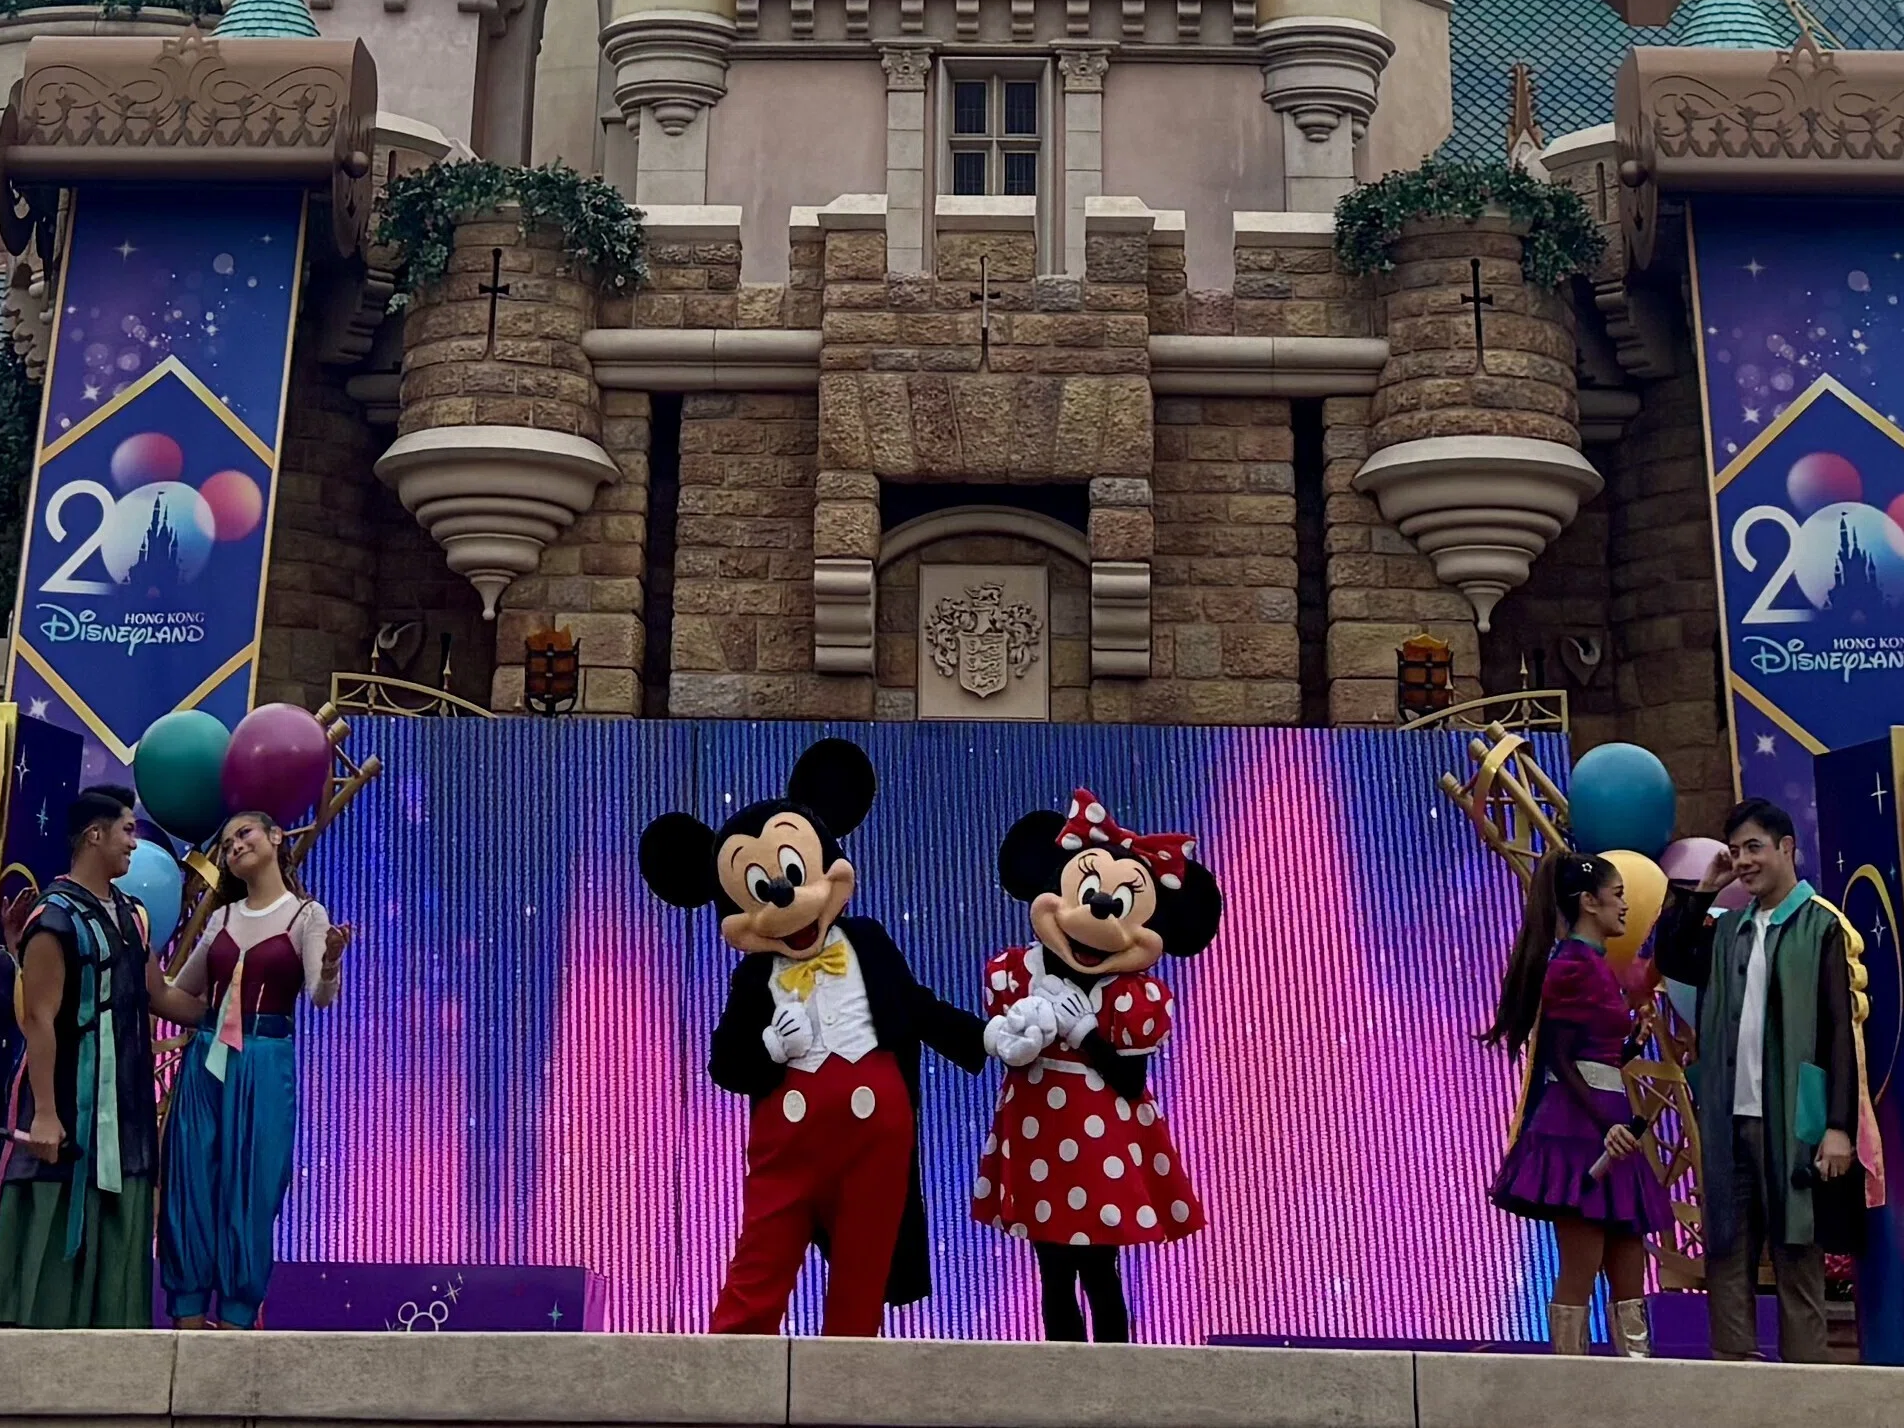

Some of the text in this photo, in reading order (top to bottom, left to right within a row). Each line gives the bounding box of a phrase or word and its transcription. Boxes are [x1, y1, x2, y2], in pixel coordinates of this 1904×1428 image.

[38, 479, 216, 595] 20
[124, 611, 205, 625] HONG KONG
[1833, 638, 1876, 650] HONG
